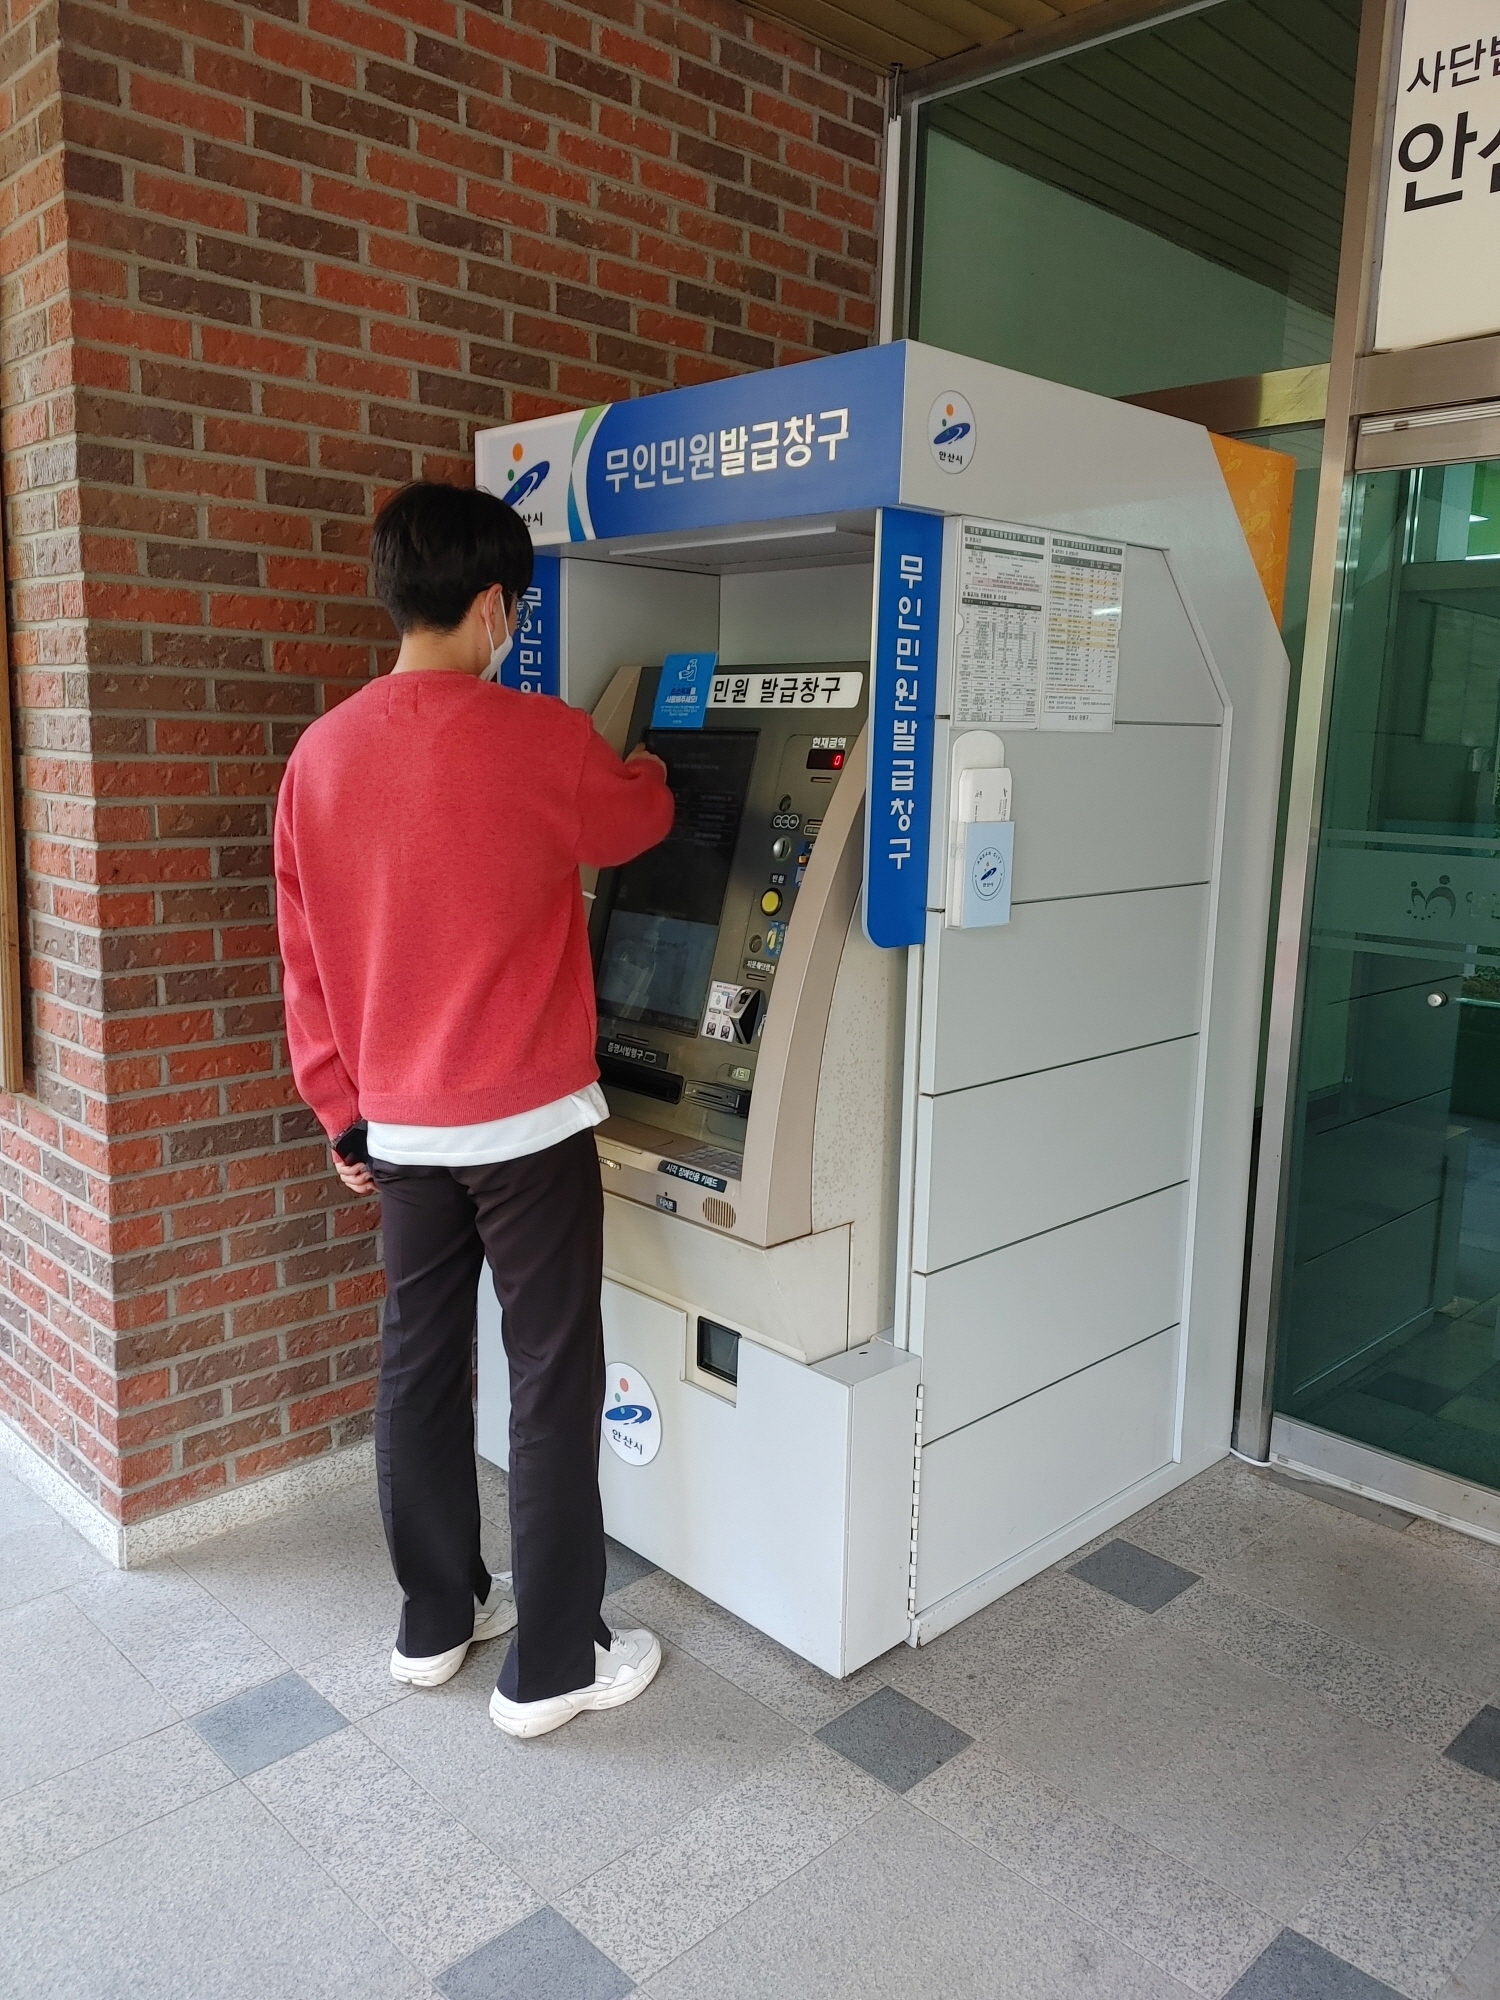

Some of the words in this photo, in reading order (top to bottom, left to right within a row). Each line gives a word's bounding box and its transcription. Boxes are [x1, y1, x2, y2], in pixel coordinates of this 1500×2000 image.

[1406, 35, 1500, 93] 사단
[605, 407, 849, 493] 무인민원발급창구
[938, 450, 963, 465] 안산시
[713, 677, 750, 703] 민원
[759, 676, 841, 704] 발급창구
[888, 554, 924, 870] 무인민원발급창구
[812, 736, 847, 749] 현재금액
[833, 754, 842, 766] 0
[612, 1428, 643, 1456] 안산시
